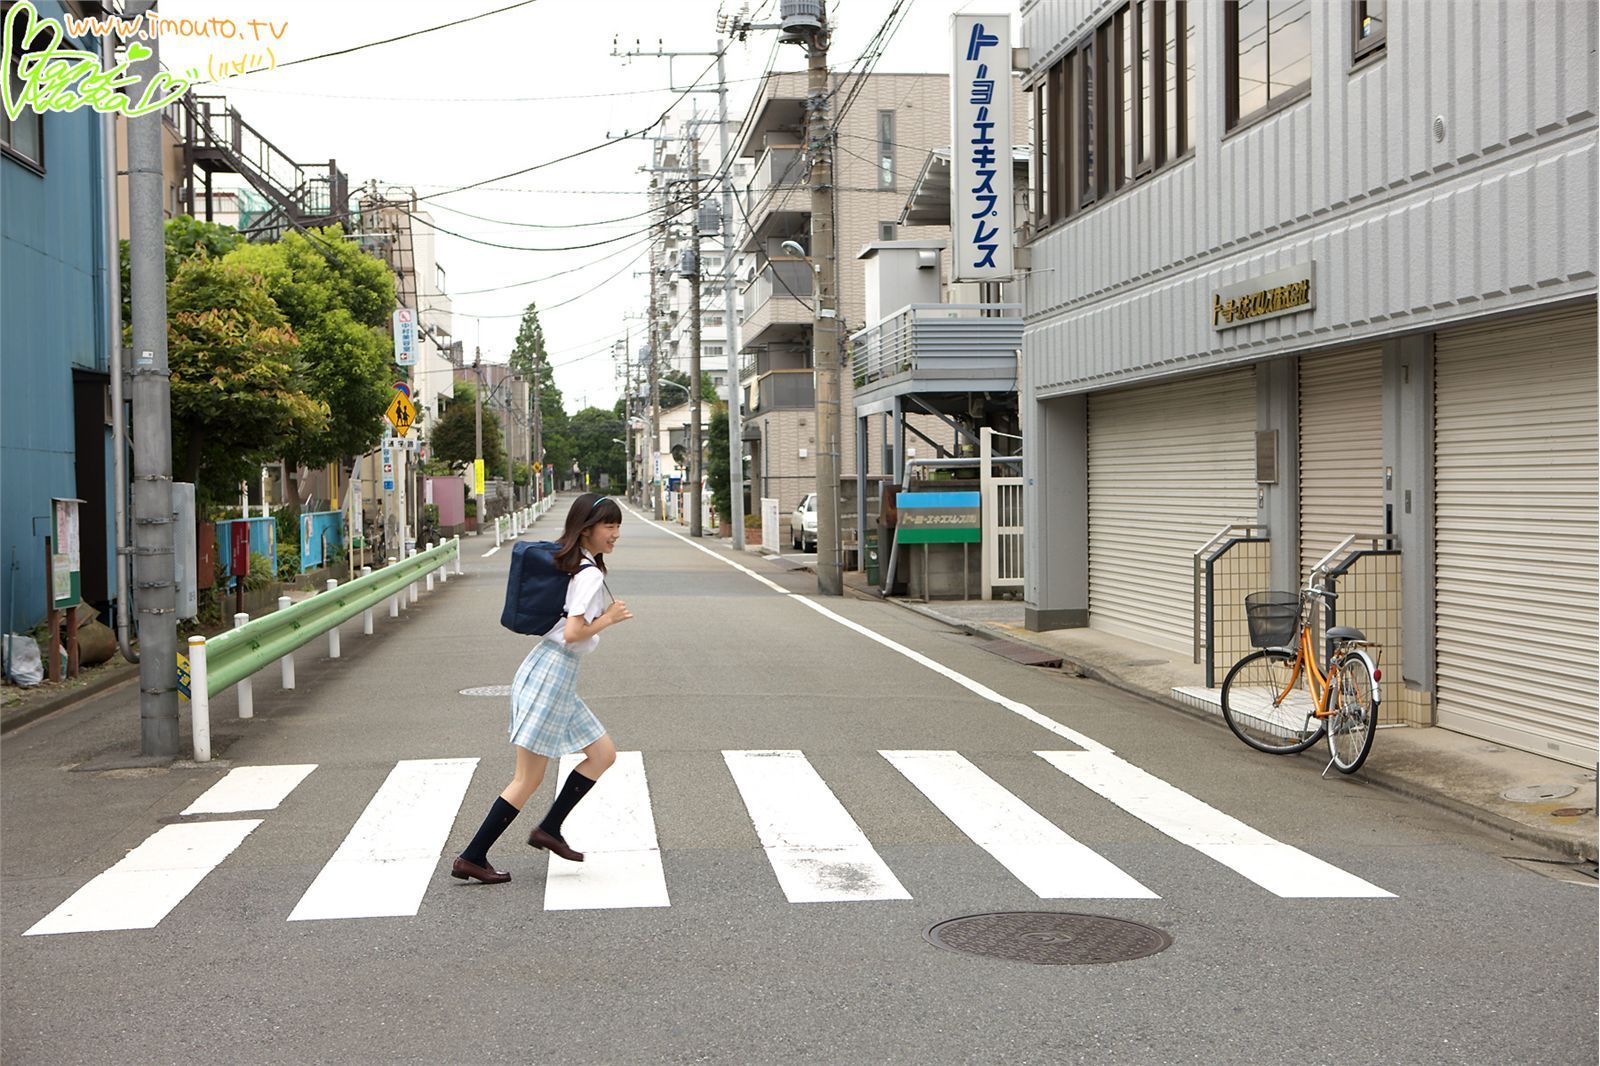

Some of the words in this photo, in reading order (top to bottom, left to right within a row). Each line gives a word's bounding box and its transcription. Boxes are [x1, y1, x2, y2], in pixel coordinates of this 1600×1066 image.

[966, 23, 999, 268] トーヨーエキスプレス
